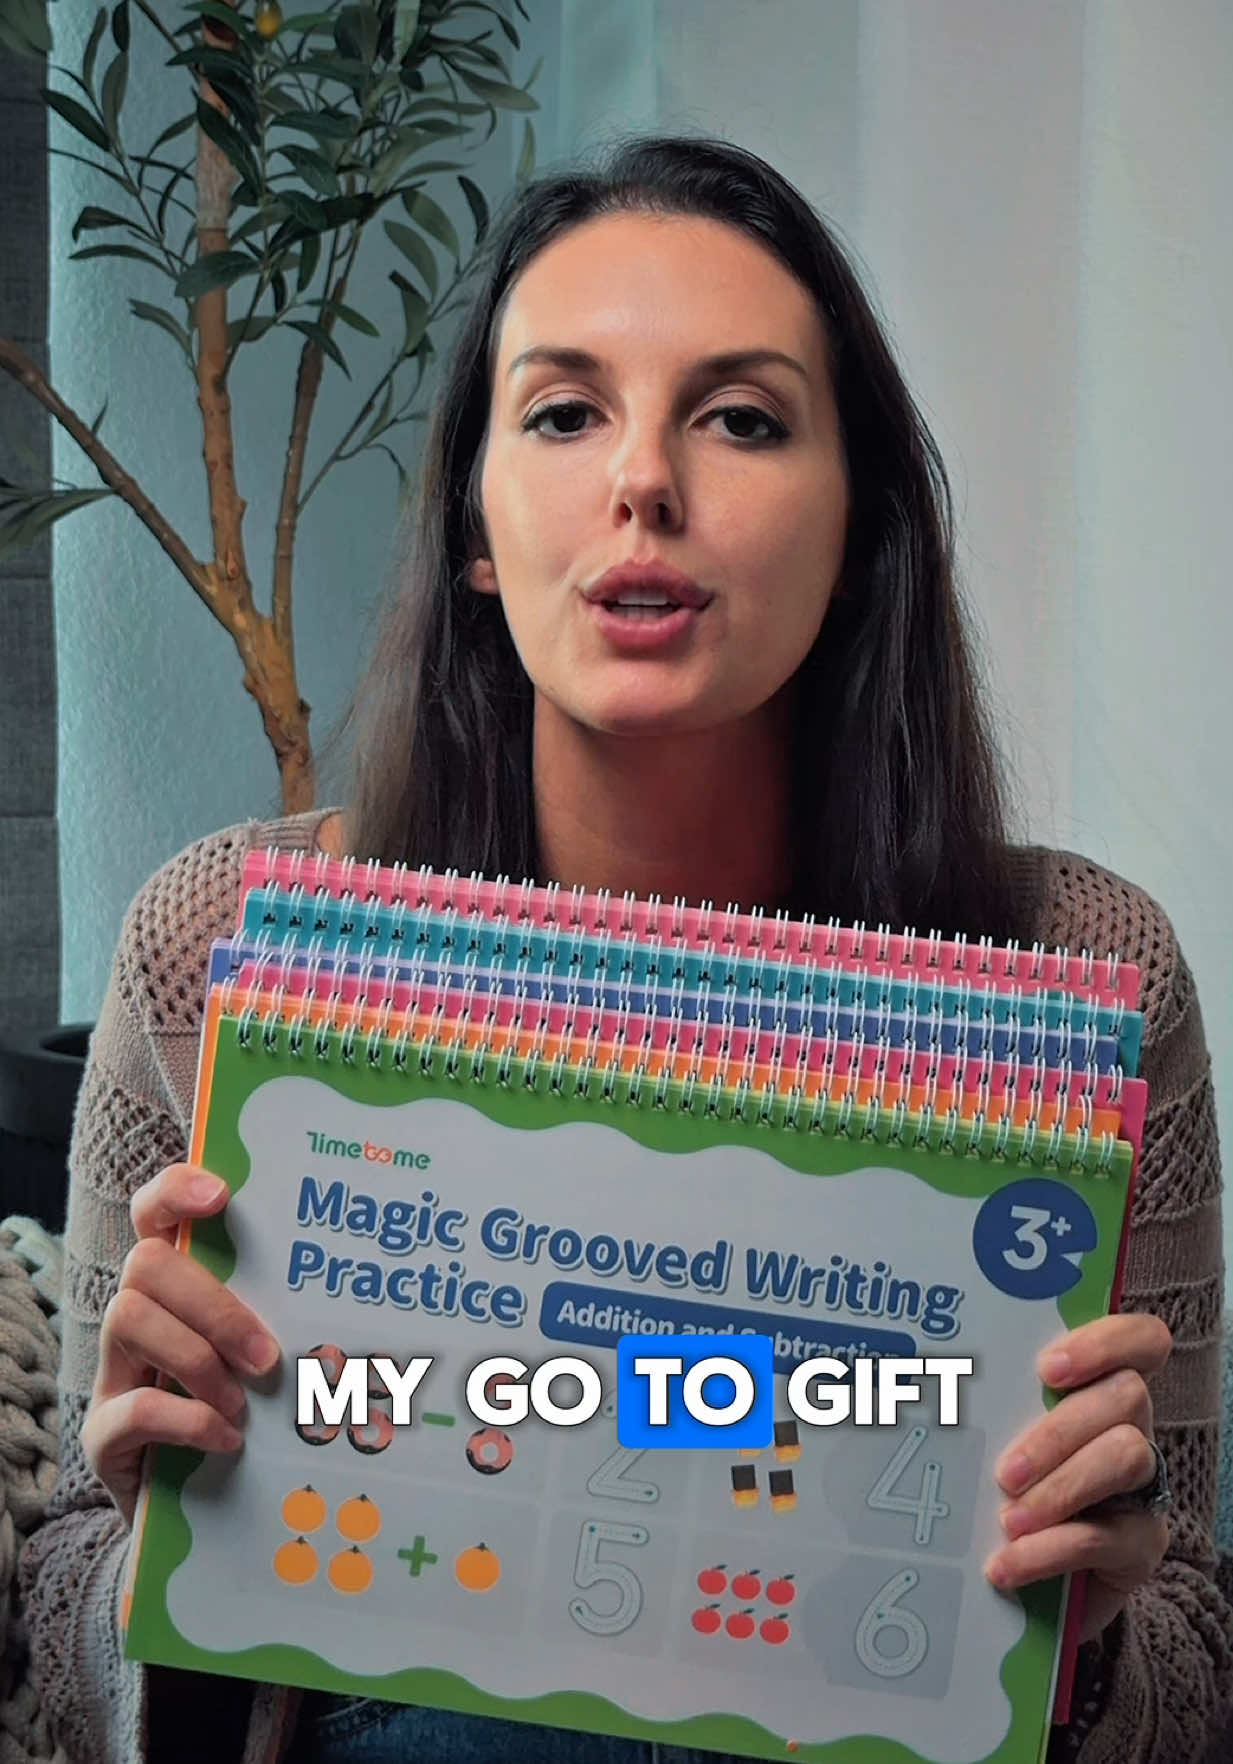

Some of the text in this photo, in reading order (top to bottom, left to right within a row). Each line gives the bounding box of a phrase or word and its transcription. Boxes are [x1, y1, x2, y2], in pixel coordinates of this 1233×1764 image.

[287, 1239, 527, 1329] Practice
[296, 1175, 964, 1340] Magic Grooved Writing
[556, 1299, 676, 1336] Addition
[740, 1327, 901, 1367] btracti
[865, 1424, 951, 1545] 4
[568, 1519, 650, 1637] 5
[855, 1567, 930, 1679] 6
